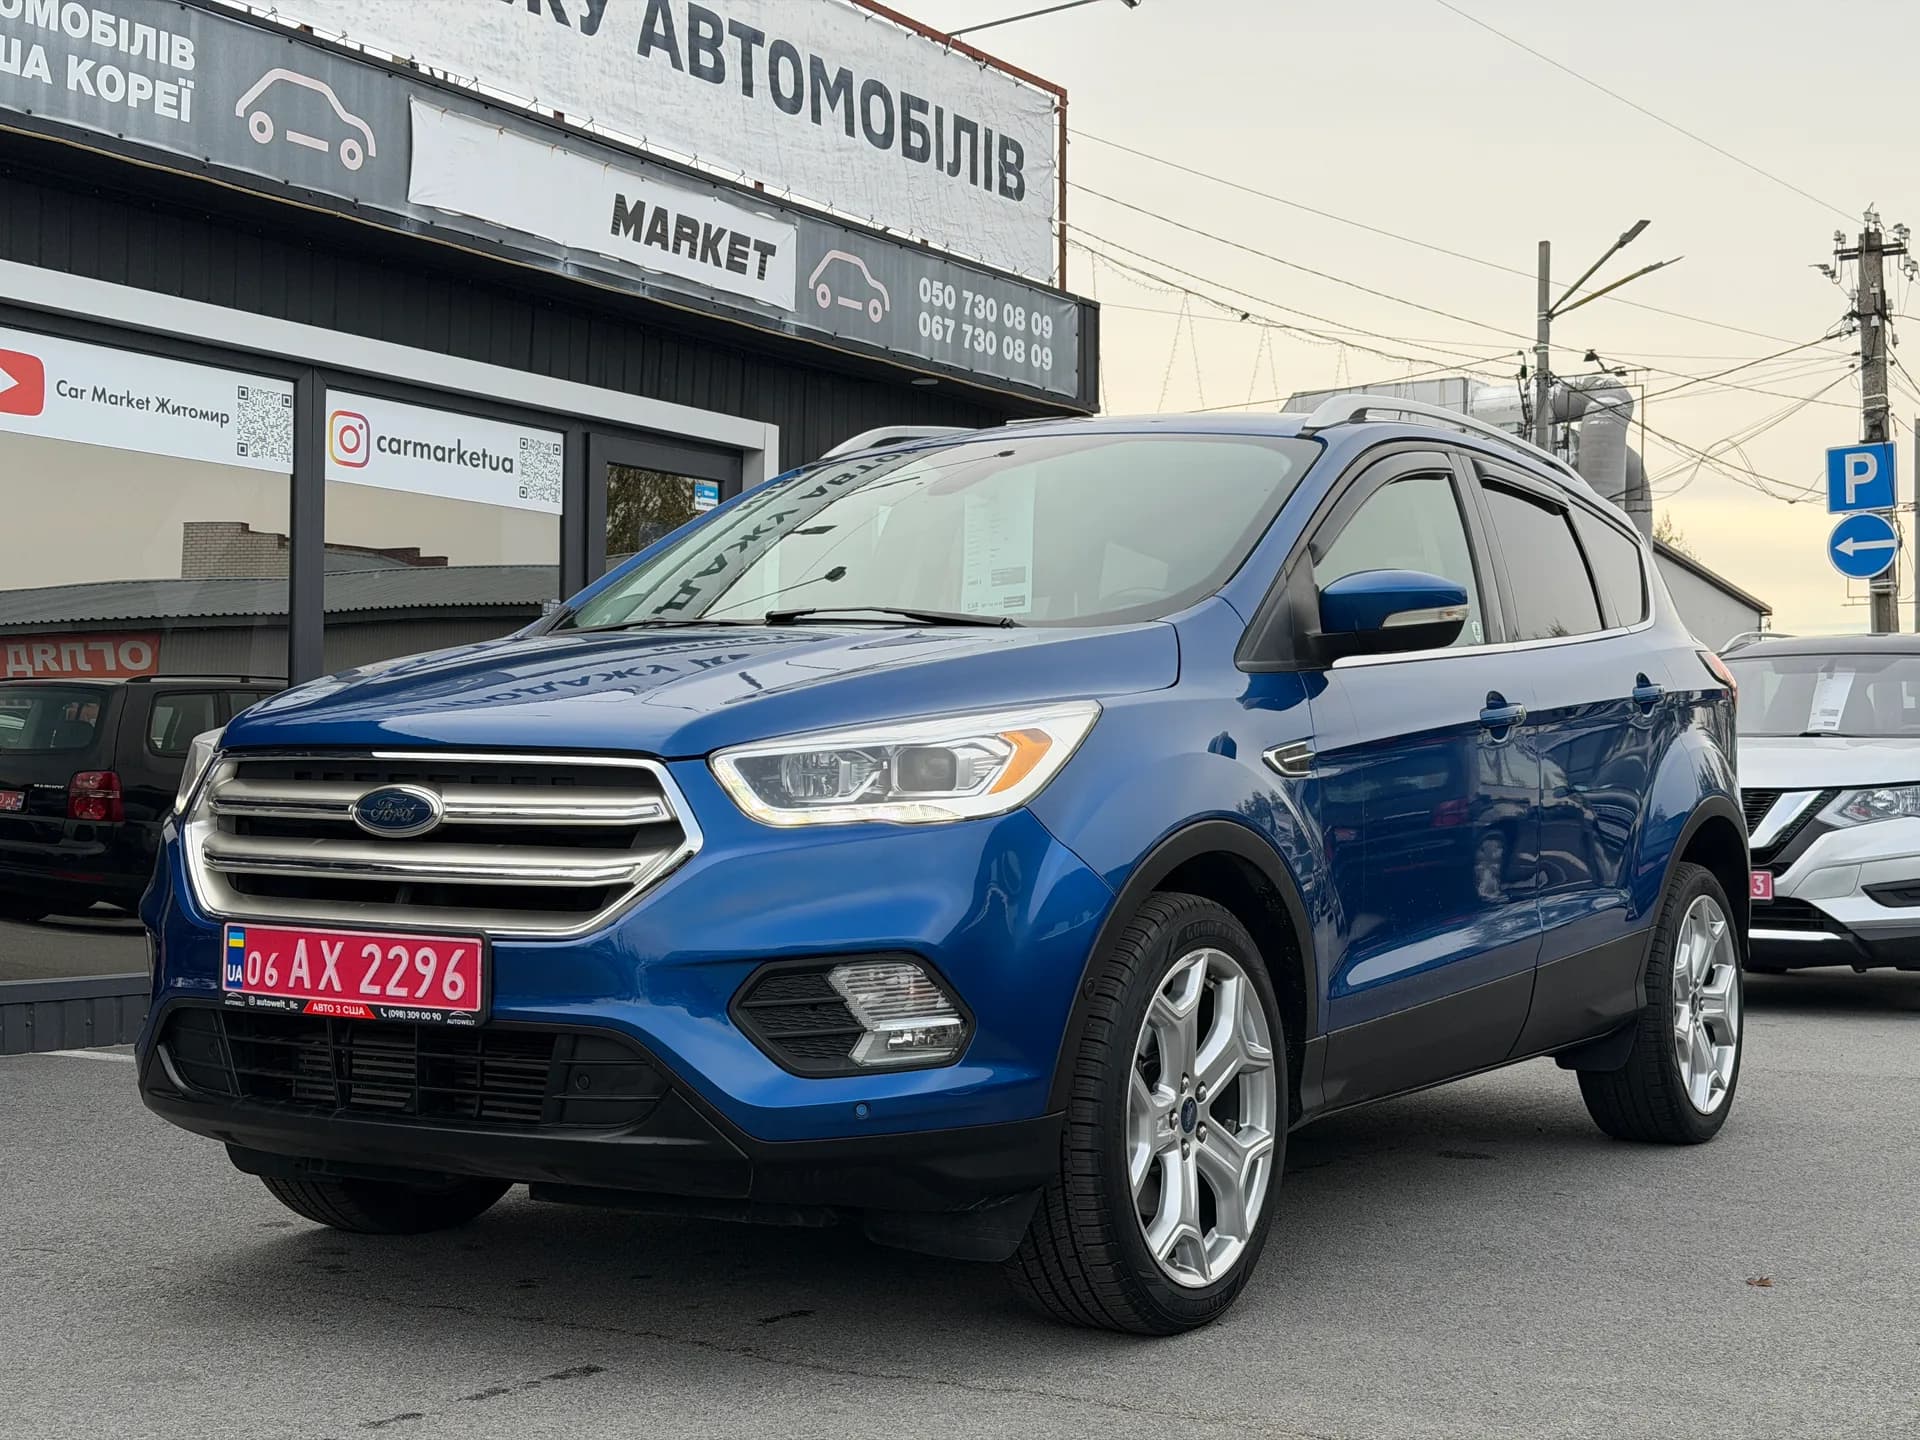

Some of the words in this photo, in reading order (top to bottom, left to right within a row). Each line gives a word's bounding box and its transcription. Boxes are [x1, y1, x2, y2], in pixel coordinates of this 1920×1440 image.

[67, 54, 195, 123] КОРЕЇ
[637, 0, 1026, 202] АВТОМОБІЛІВ
[611, 193, 776, 280] MARKET
[919, 277, 956, 310] 050
[962, 290, 998, 322] 730
[1003, 303, 1026, 331] 08
[1031, 312, 1053, 339] 09
[918, 312, 955, 344] 067
[962, 323, 997, 356] 730
[1002, 335, 1026, 363] 08
[1031, 344, 1053, 371] 09
[56, 380, 86, 400] Car
[91, 385, 151, 411] Market
[155, 396, 230, 428] Житомир
[376, 435, 514, 474] carmarketua
[1845, 452, 1878, 504] P
[370, 798, 417, 822] Ford
[1753, 875, 1765, 895] 3
[227, 964, 243, 982] UA
[247, 951, 279, 988] 06
[288, 938, 345, 992] AX
[359, 943, 466, 1000] 2296
[312, 1003, 334, 1013] АВТО
[343, 1005, 365, 1016] США
[406, 1010, 420, 1019] 309
[421, 1011, 431, 1020] 00
[432, 1012, 442, 1020] 90
[447, 1018, 475, 1026] AUTOWELT
